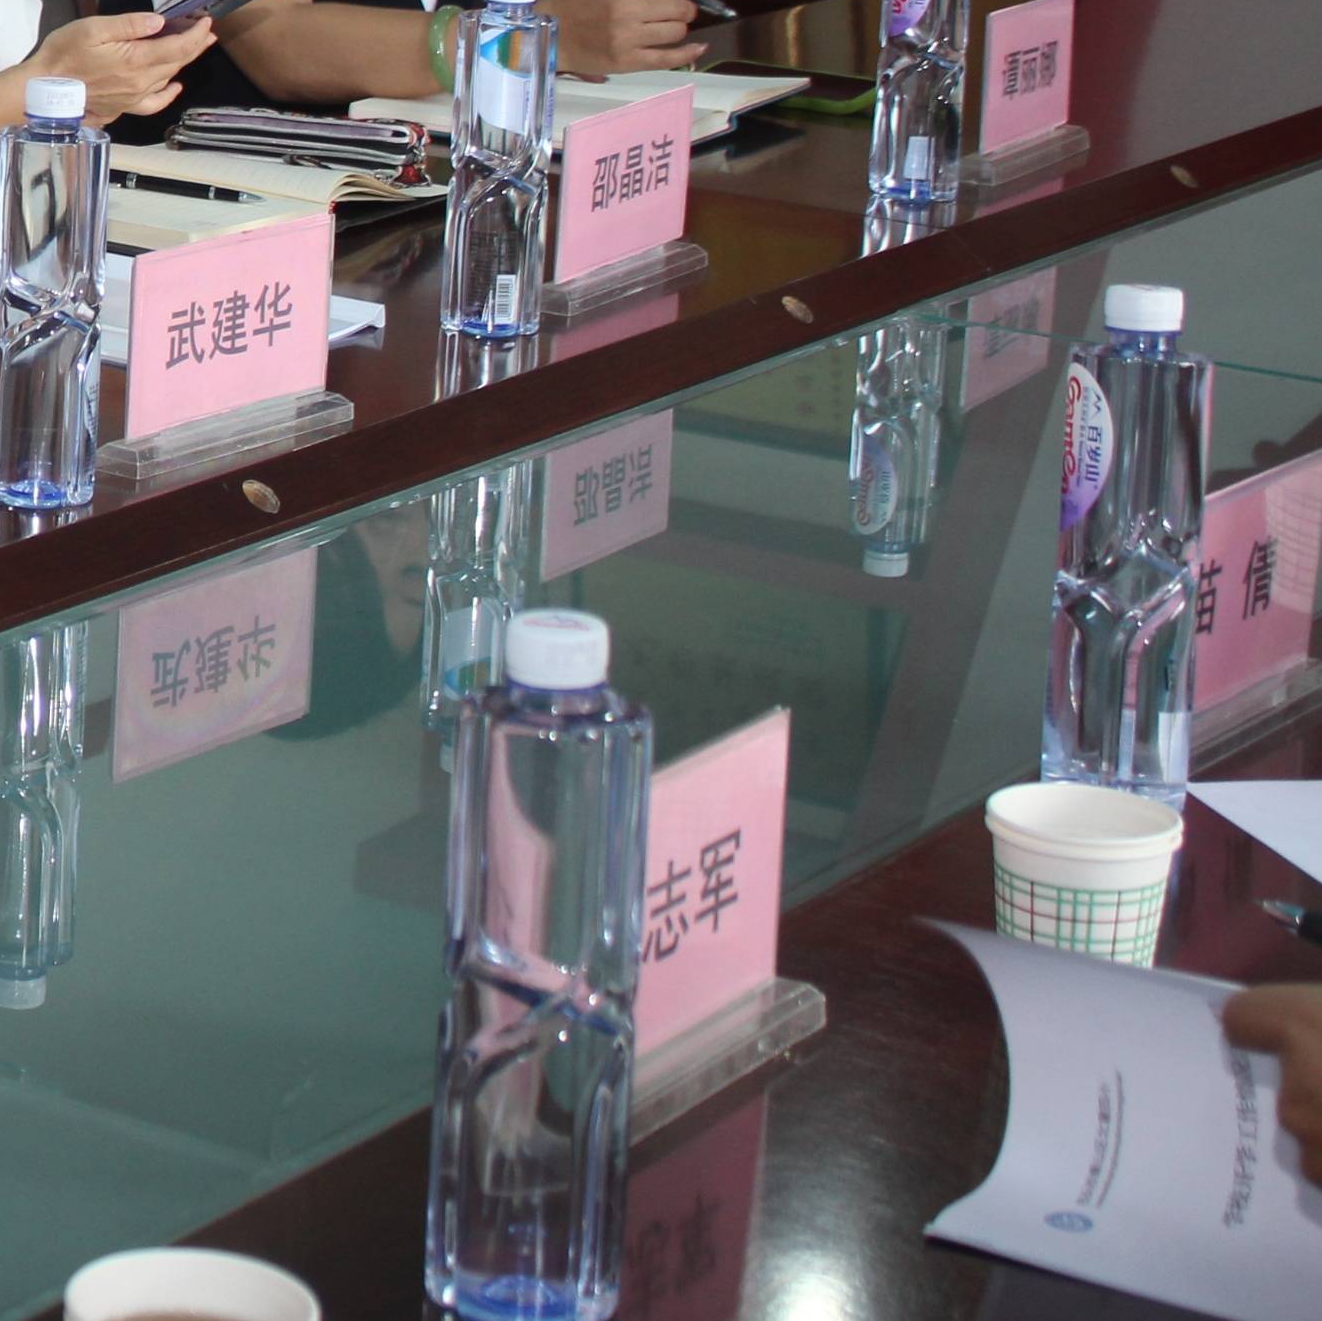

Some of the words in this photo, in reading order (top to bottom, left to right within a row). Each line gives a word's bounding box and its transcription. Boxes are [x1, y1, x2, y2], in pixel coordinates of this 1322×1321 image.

[591, 134, 675, 213] 邵晶洁
[165, 281, 293, 370] 武建华
[1085, 426, 1102, 482] 百岁山
